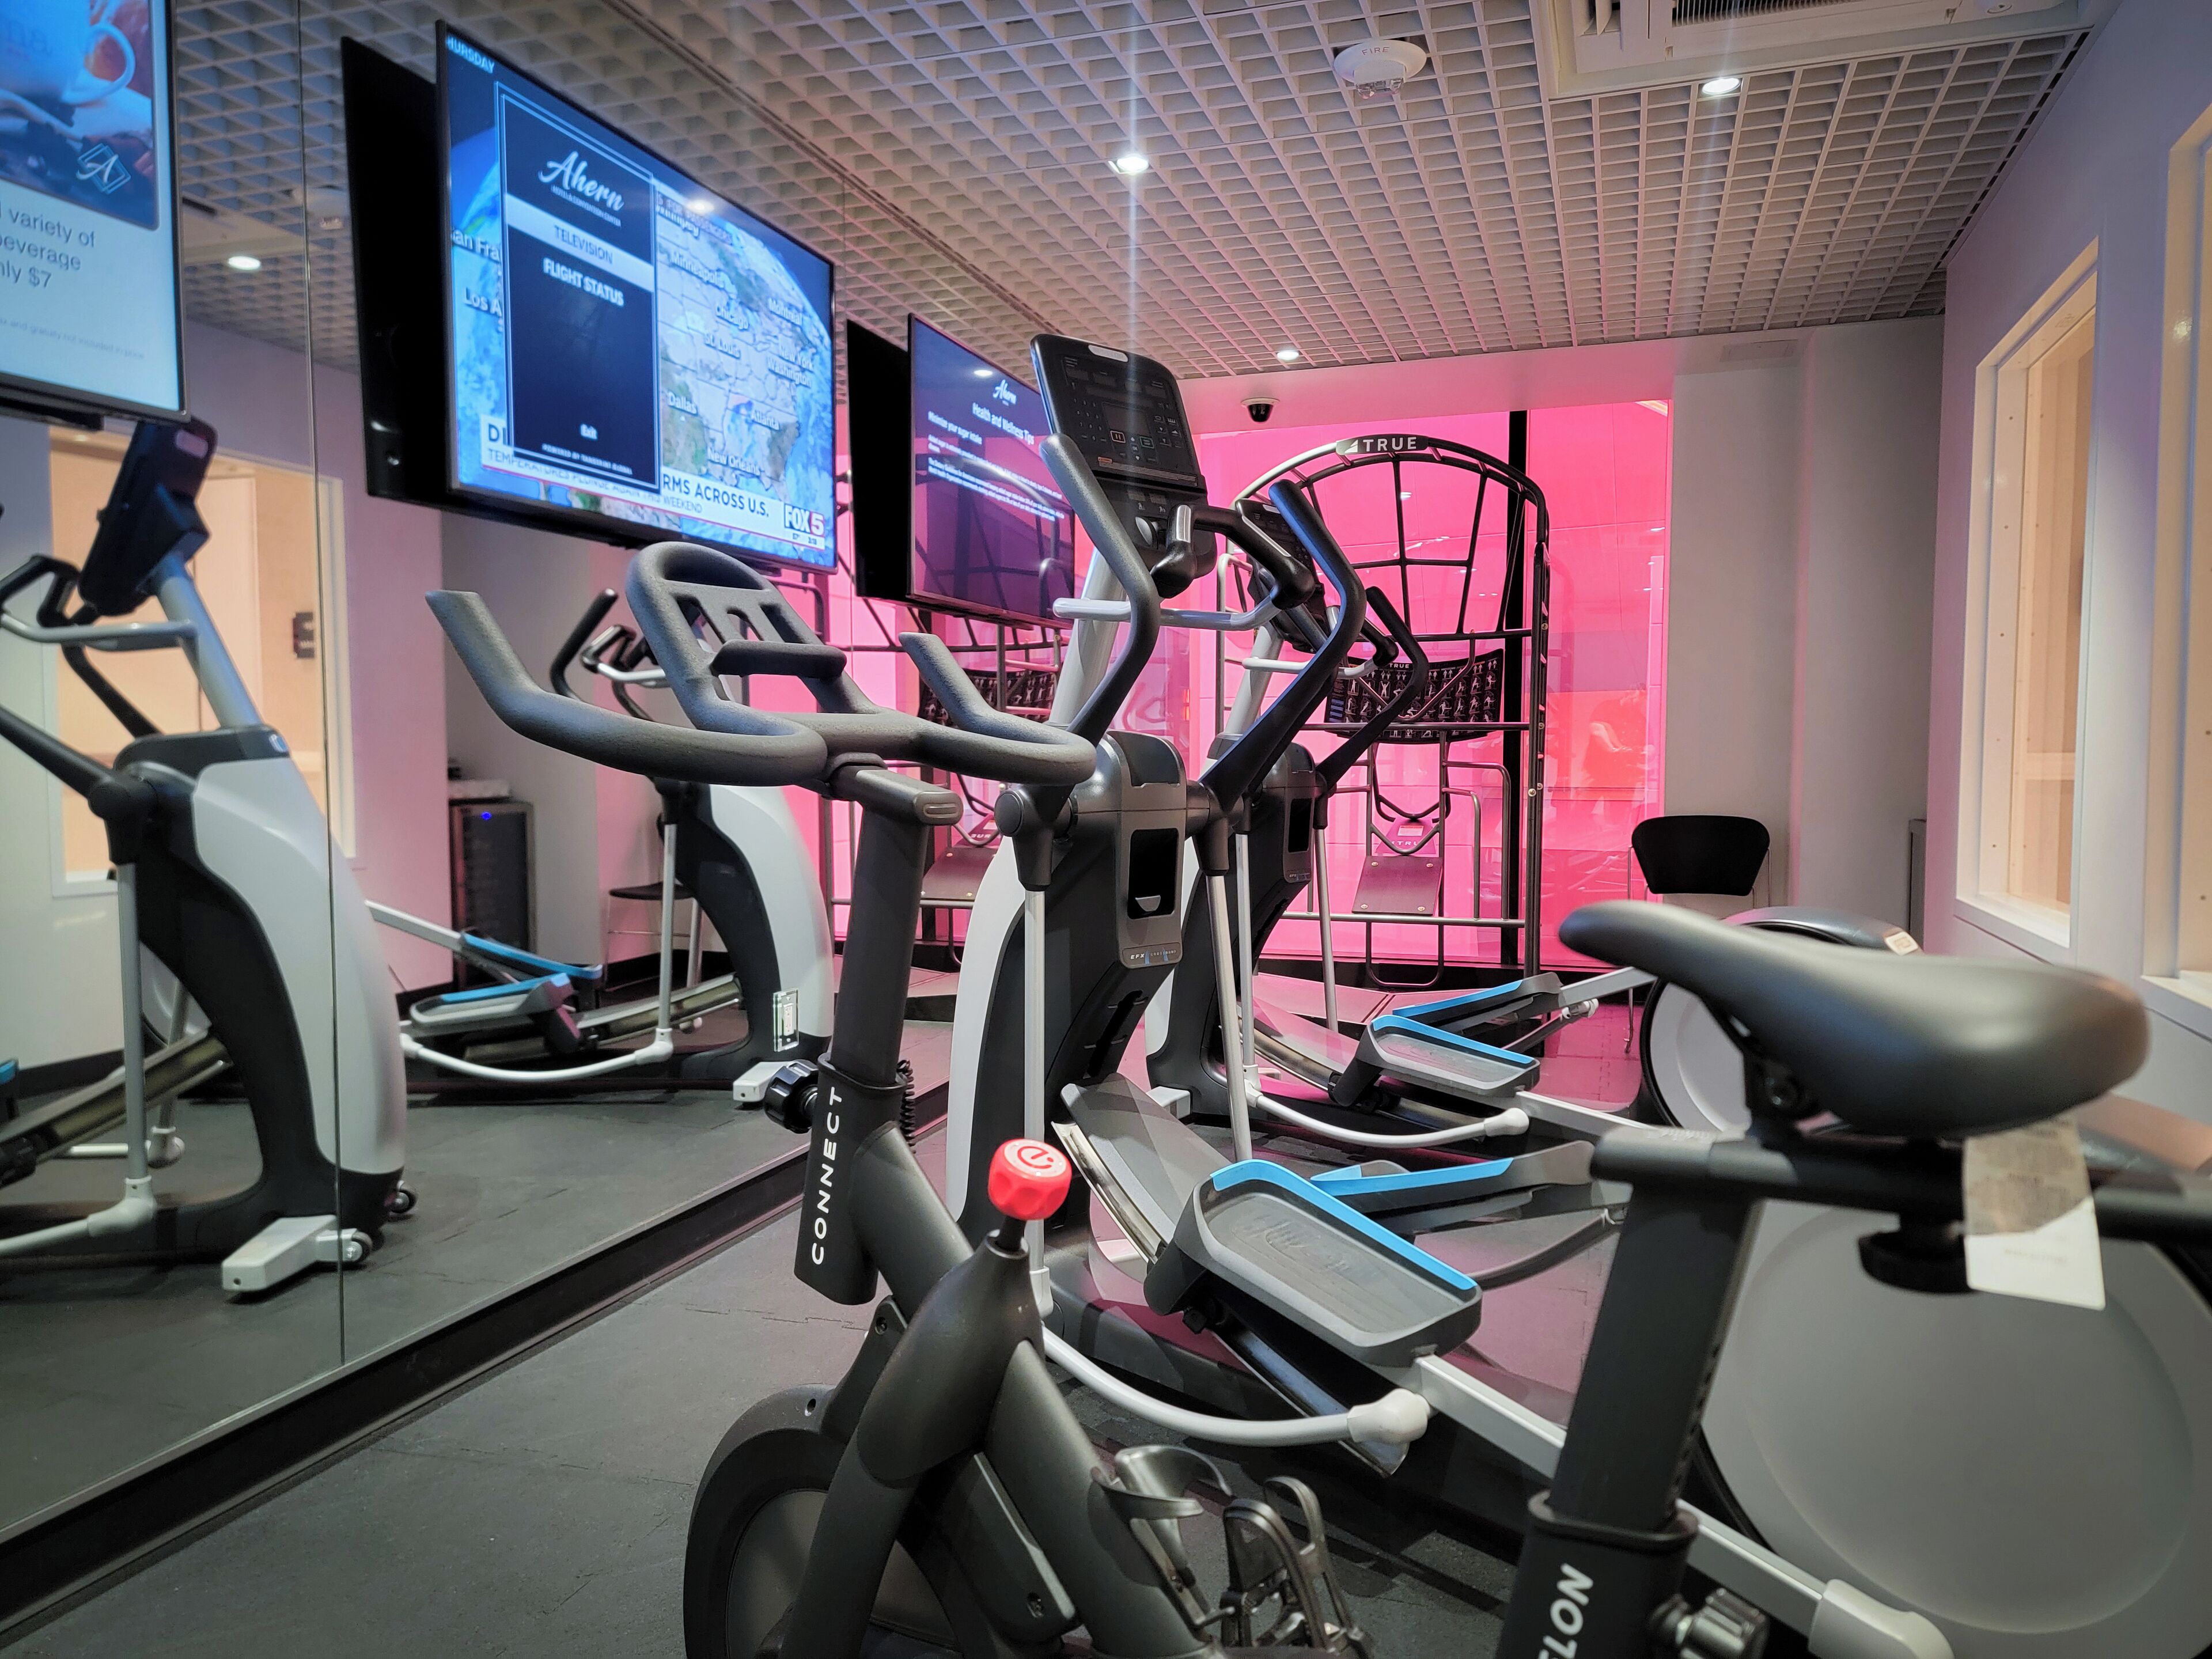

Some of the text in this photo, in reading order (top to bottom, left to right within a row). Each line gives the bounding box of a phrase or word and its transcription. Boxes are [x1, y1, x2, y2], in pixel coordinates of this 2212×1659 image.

[1361, 46, 1389, 55] FIRE
[538, 151, 624, 211] Ahern
[9, 209, 72, 243] variety
[79, 231, 94, 247] of
[554, 225, 613, 264] TELEVISION
[29, 267, 51, 287] $7
[543, 257, 624, 306] FLIGHT STATUS
[463, 287, 488, 311] Los
[767, 357, 811, 387] Washington
[779, 344, 814, 372] New York
[668, 392, 697, 414] Dallas
[580, 423, 599, 440] Exit
[752, 410, 779, 430] Atlanta
[972, 402, 1035, 445] Health and Wellness Tips
[1363, 437, 1417, 452] TRUE
[708, 448, 762, 476] New Orleans
[663, 474, 770, 517] RMS ACROSS U.S.
[663, 496, 703, 513] WEEKEND
[812, 1086, 842, 1265] CONNECT
